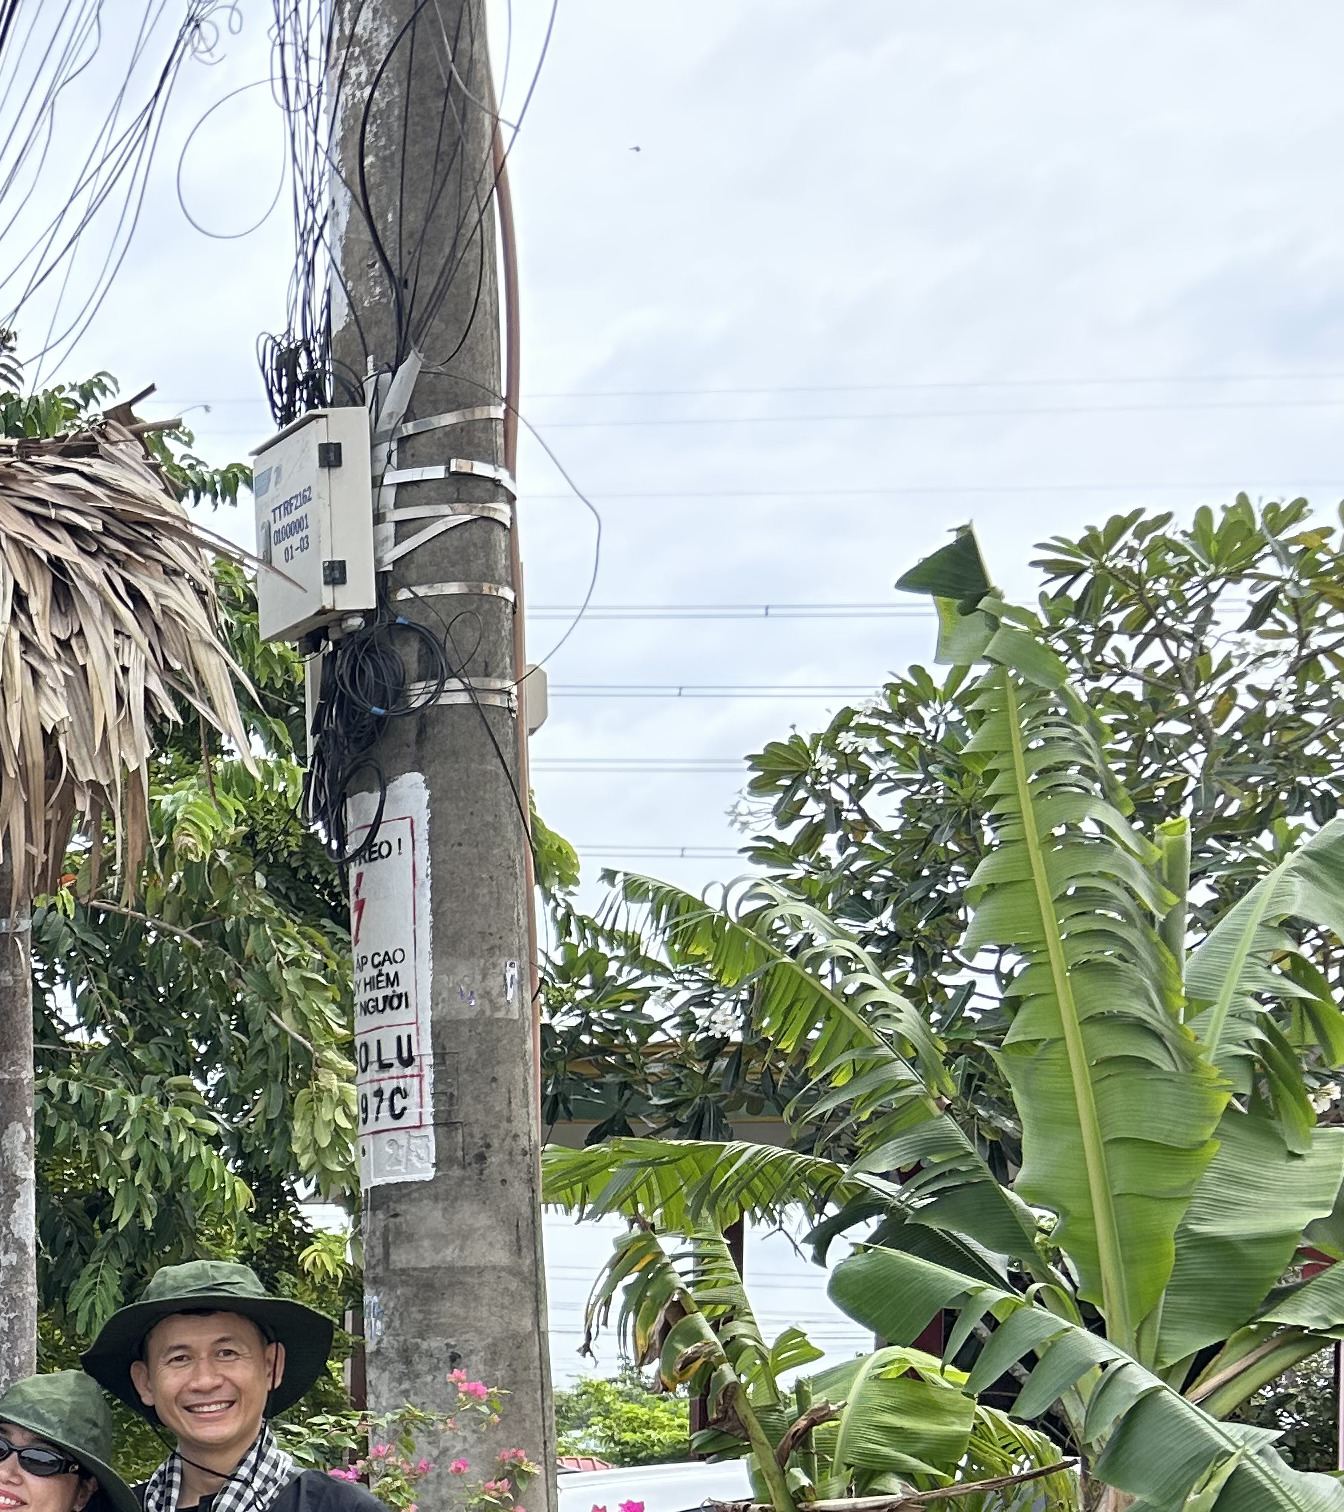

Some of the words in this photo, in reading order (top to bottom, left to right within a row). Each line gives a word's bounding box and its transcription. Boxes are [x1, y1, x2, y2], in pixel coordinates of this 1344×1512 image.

[284, 534, 310, 563] 01-03
[371, 947, 406, 969] CAO
[364, 968, 400, 994] HIỂM
